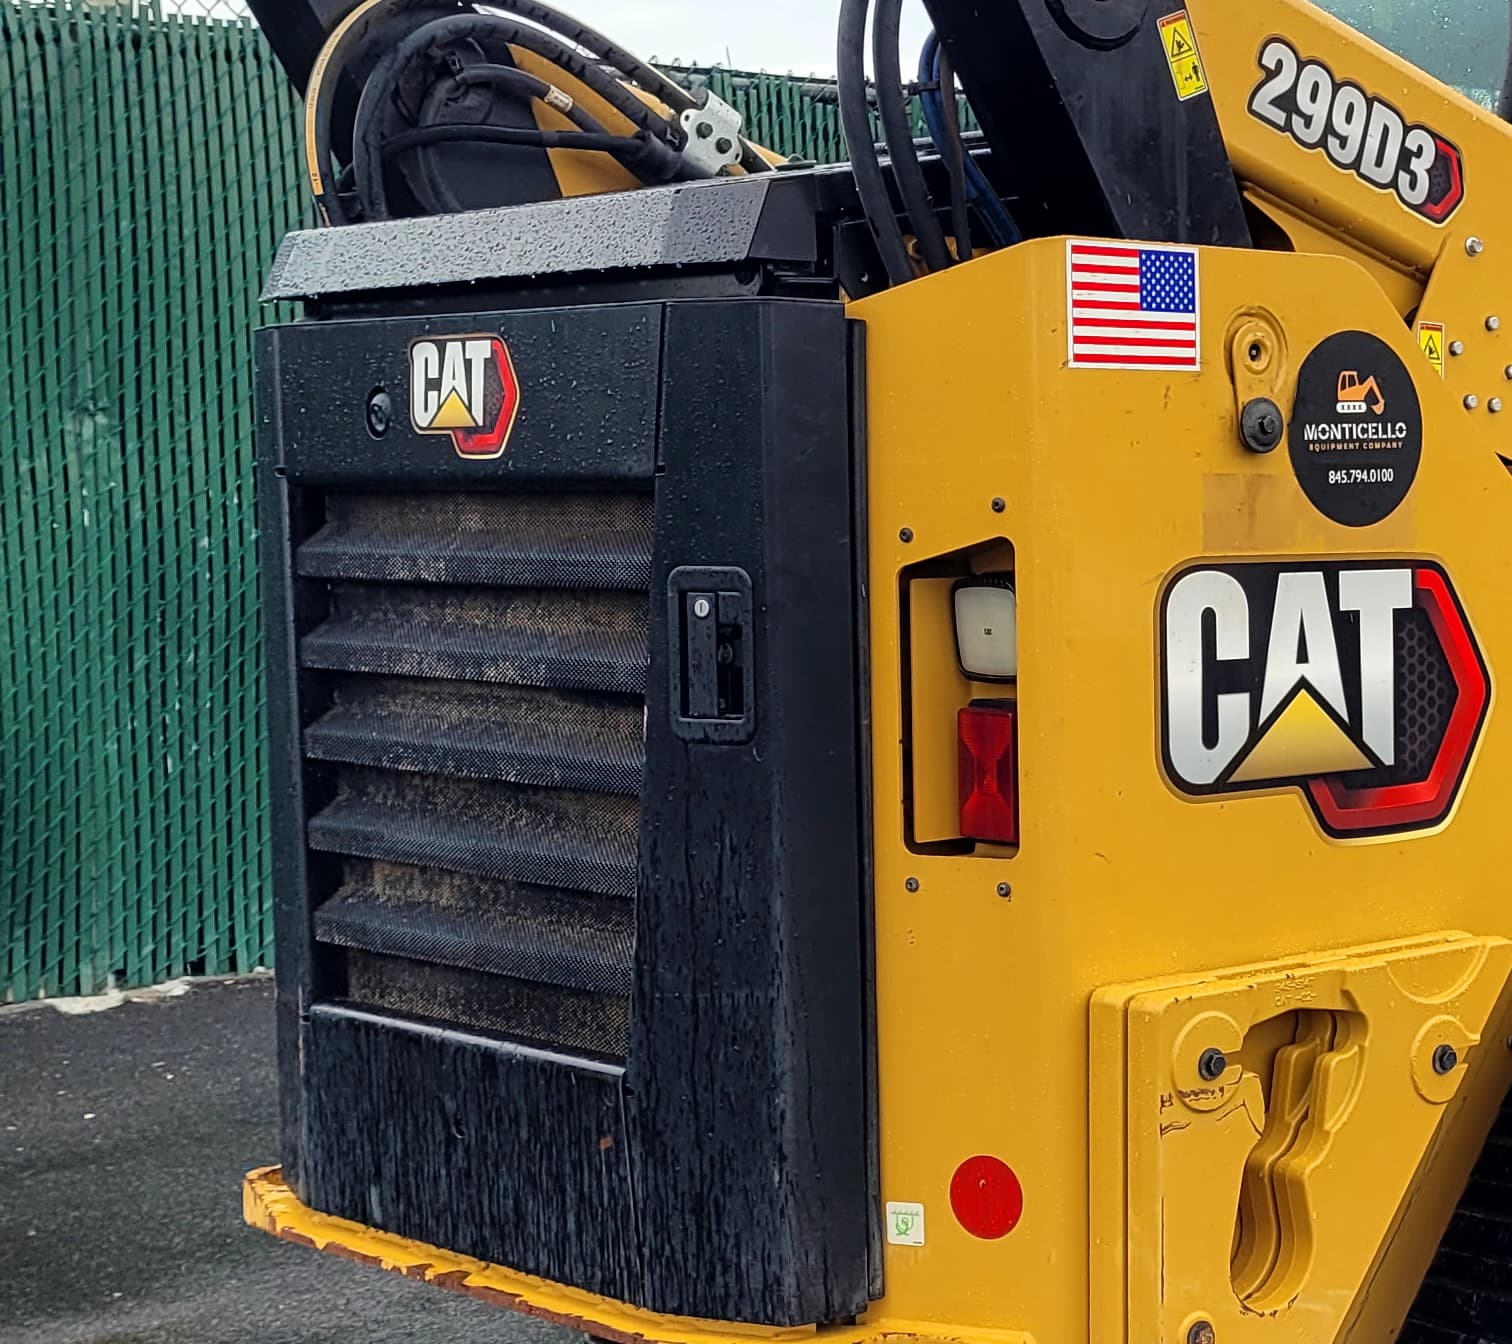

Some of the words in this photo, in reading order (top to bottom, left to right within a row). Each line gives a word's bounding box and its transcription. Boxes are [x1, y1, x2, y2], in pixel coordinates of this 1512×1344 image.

[1250, 41, 1437, 205] 299D3
[412, 339, 491, 428] CAT
[1304, 422, 1407, 441] MONTICELLO
[1309, 443, 1360, 452] EQUIPMENT
[1362, 441, 1403, 450] COMPANY
[1328, 468, 1394, 484] 845.794.0100
[1166, 568, 1413, 785] CAT
